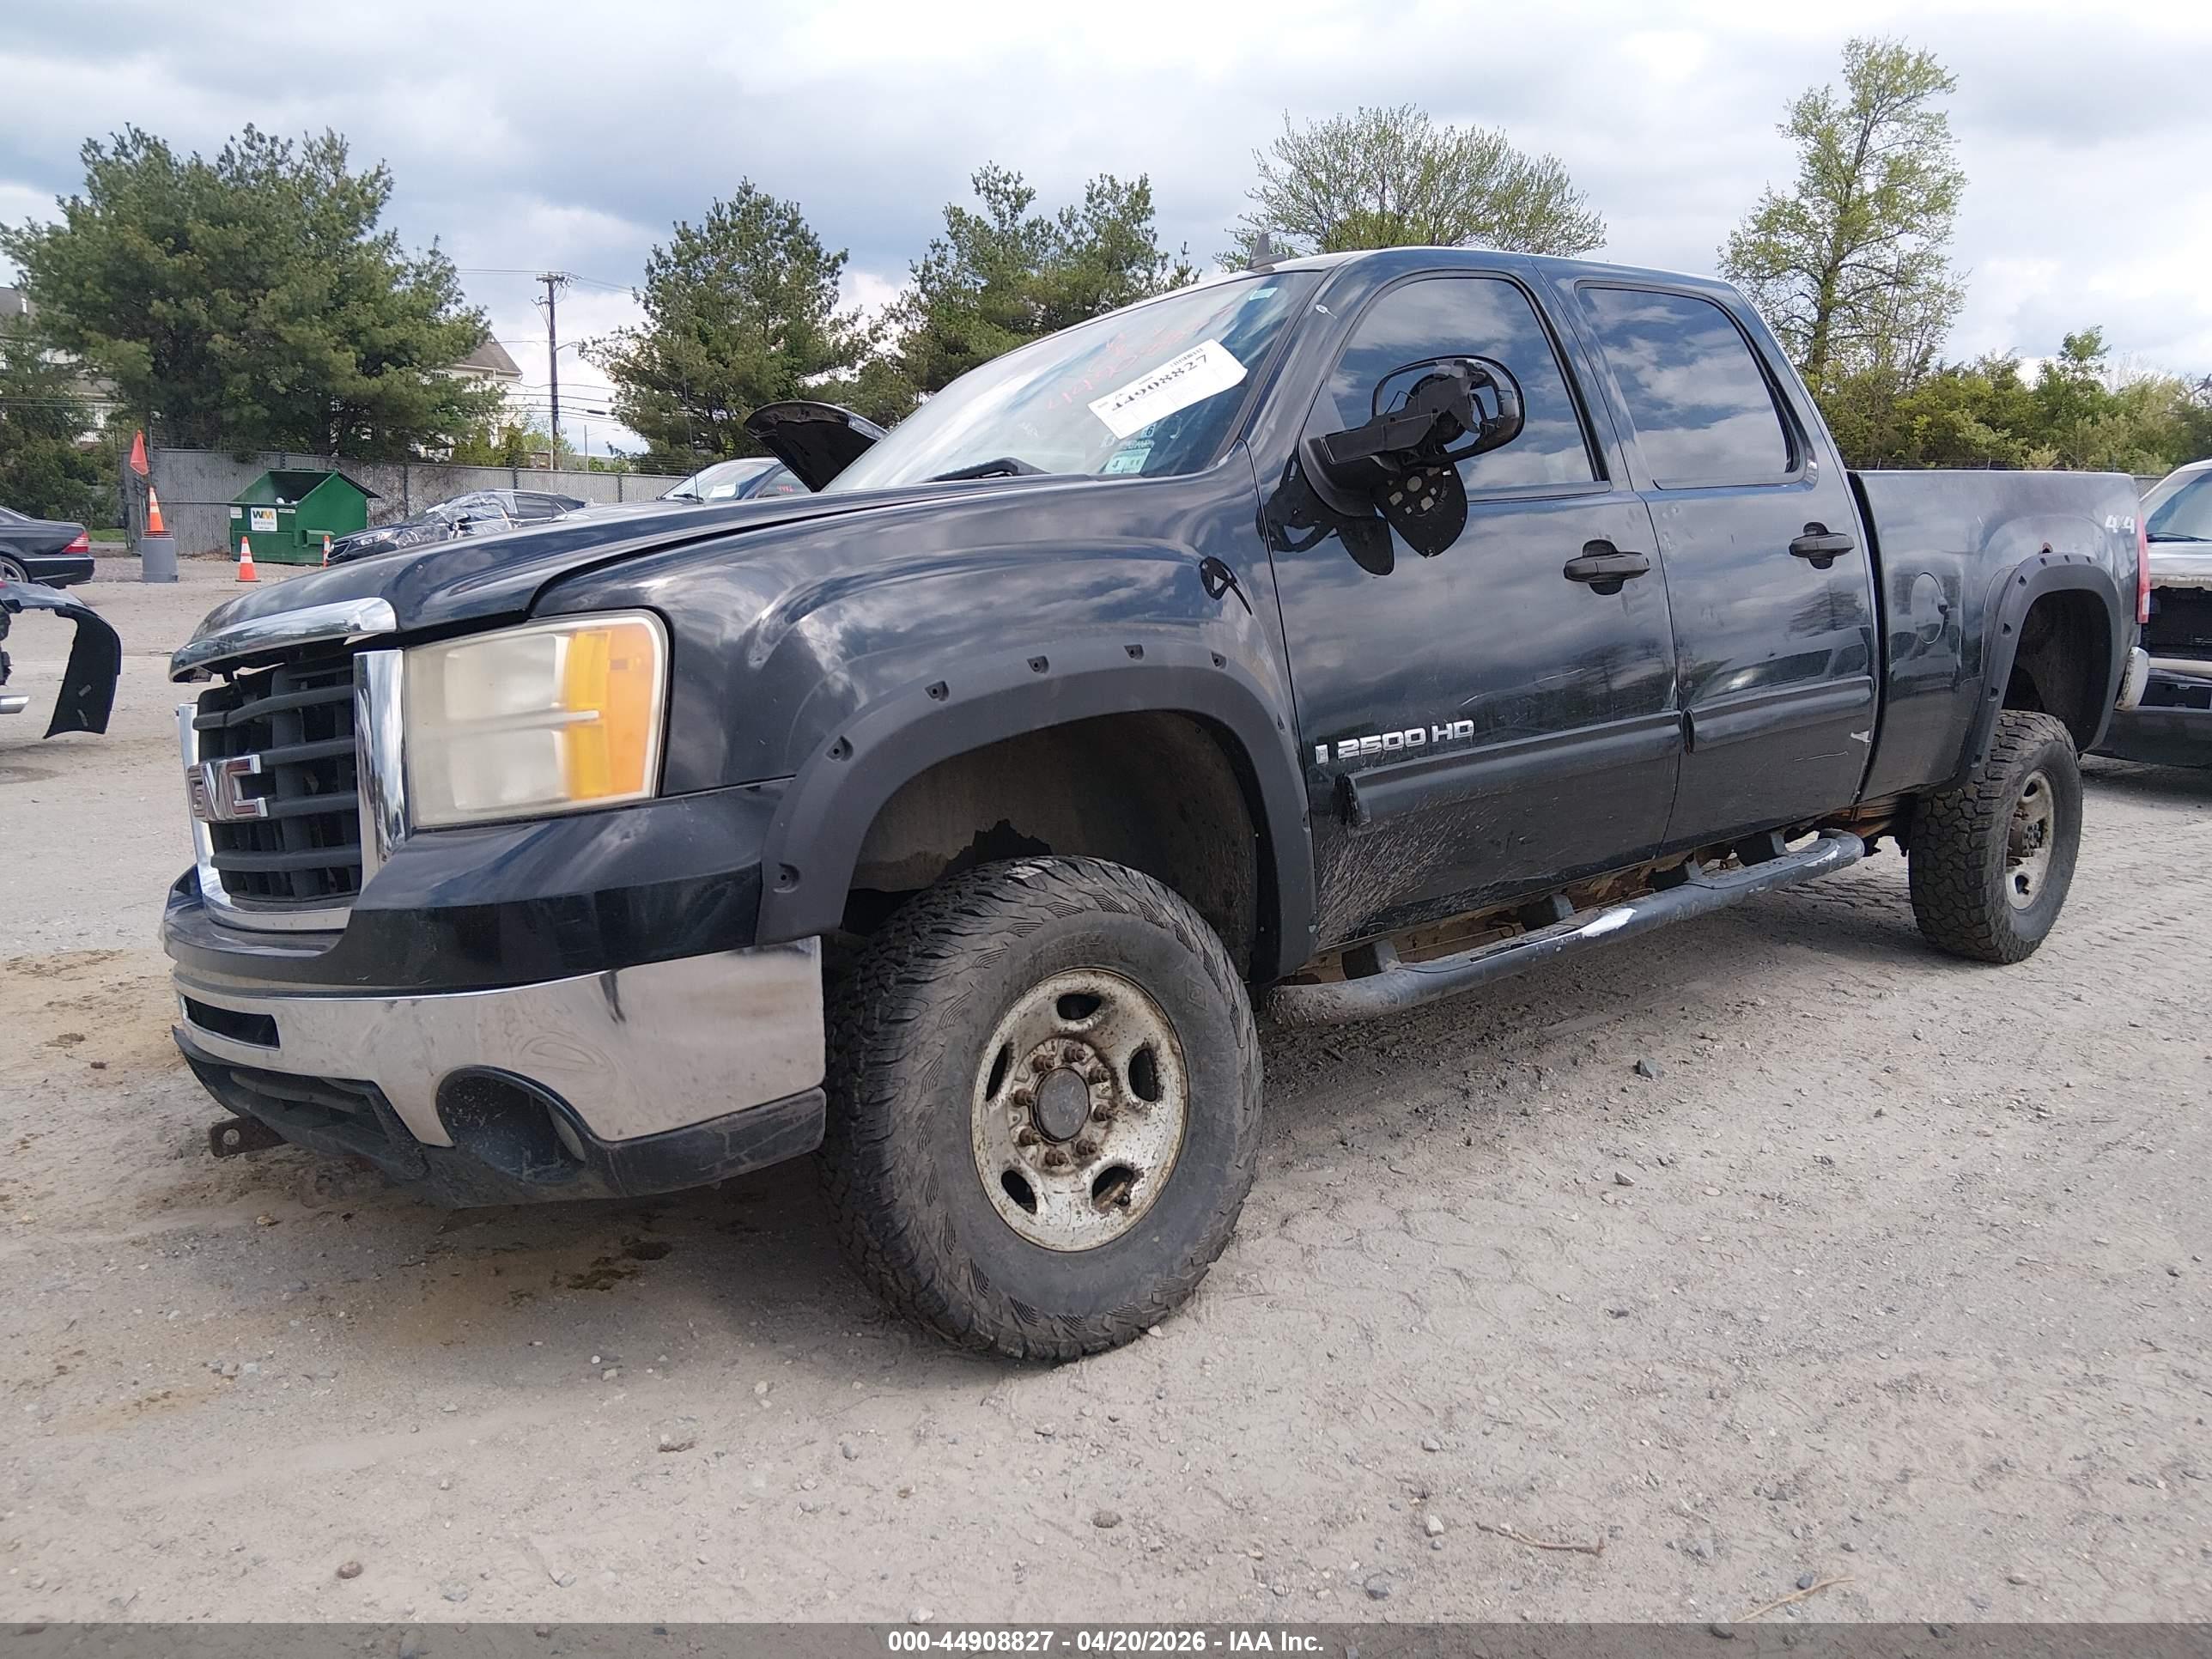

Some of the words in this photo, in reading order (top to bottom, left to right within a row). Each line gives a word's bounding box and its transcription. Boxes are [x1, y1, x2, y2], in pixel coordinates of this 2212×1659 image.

[1111, 353, 1207, 412] 44908827
[252, 510, 274, 520] WM
[1338, 727, 1426, 760] 2500
[1431, 720, 1474, 743] HD
[187, 754, 268, 822] GMC
